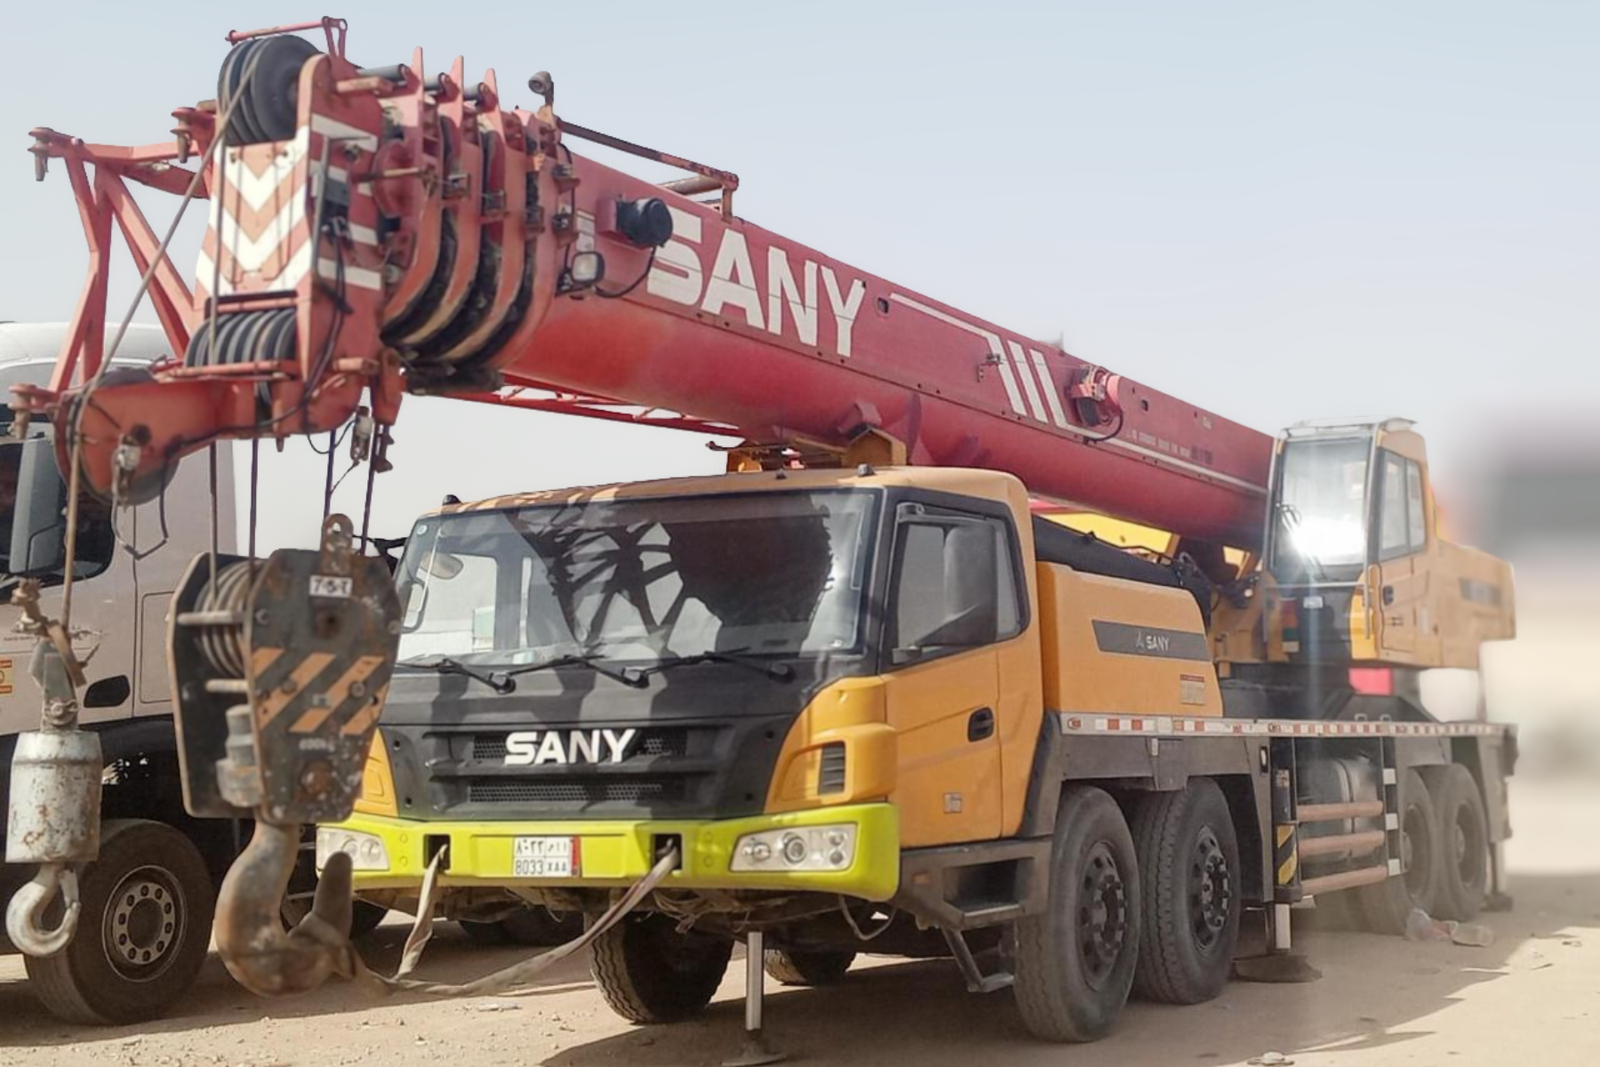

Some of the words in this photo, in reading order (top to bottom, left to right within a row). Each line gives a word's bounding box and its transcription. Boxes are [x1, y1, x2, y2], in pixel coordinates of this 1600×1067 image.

[646, 206, 866, 358] SANY
[1145, 634, 1170, 652] SANY
[503, 728, 636, 766] SANY
[515, 859, 544, 875] 8033
